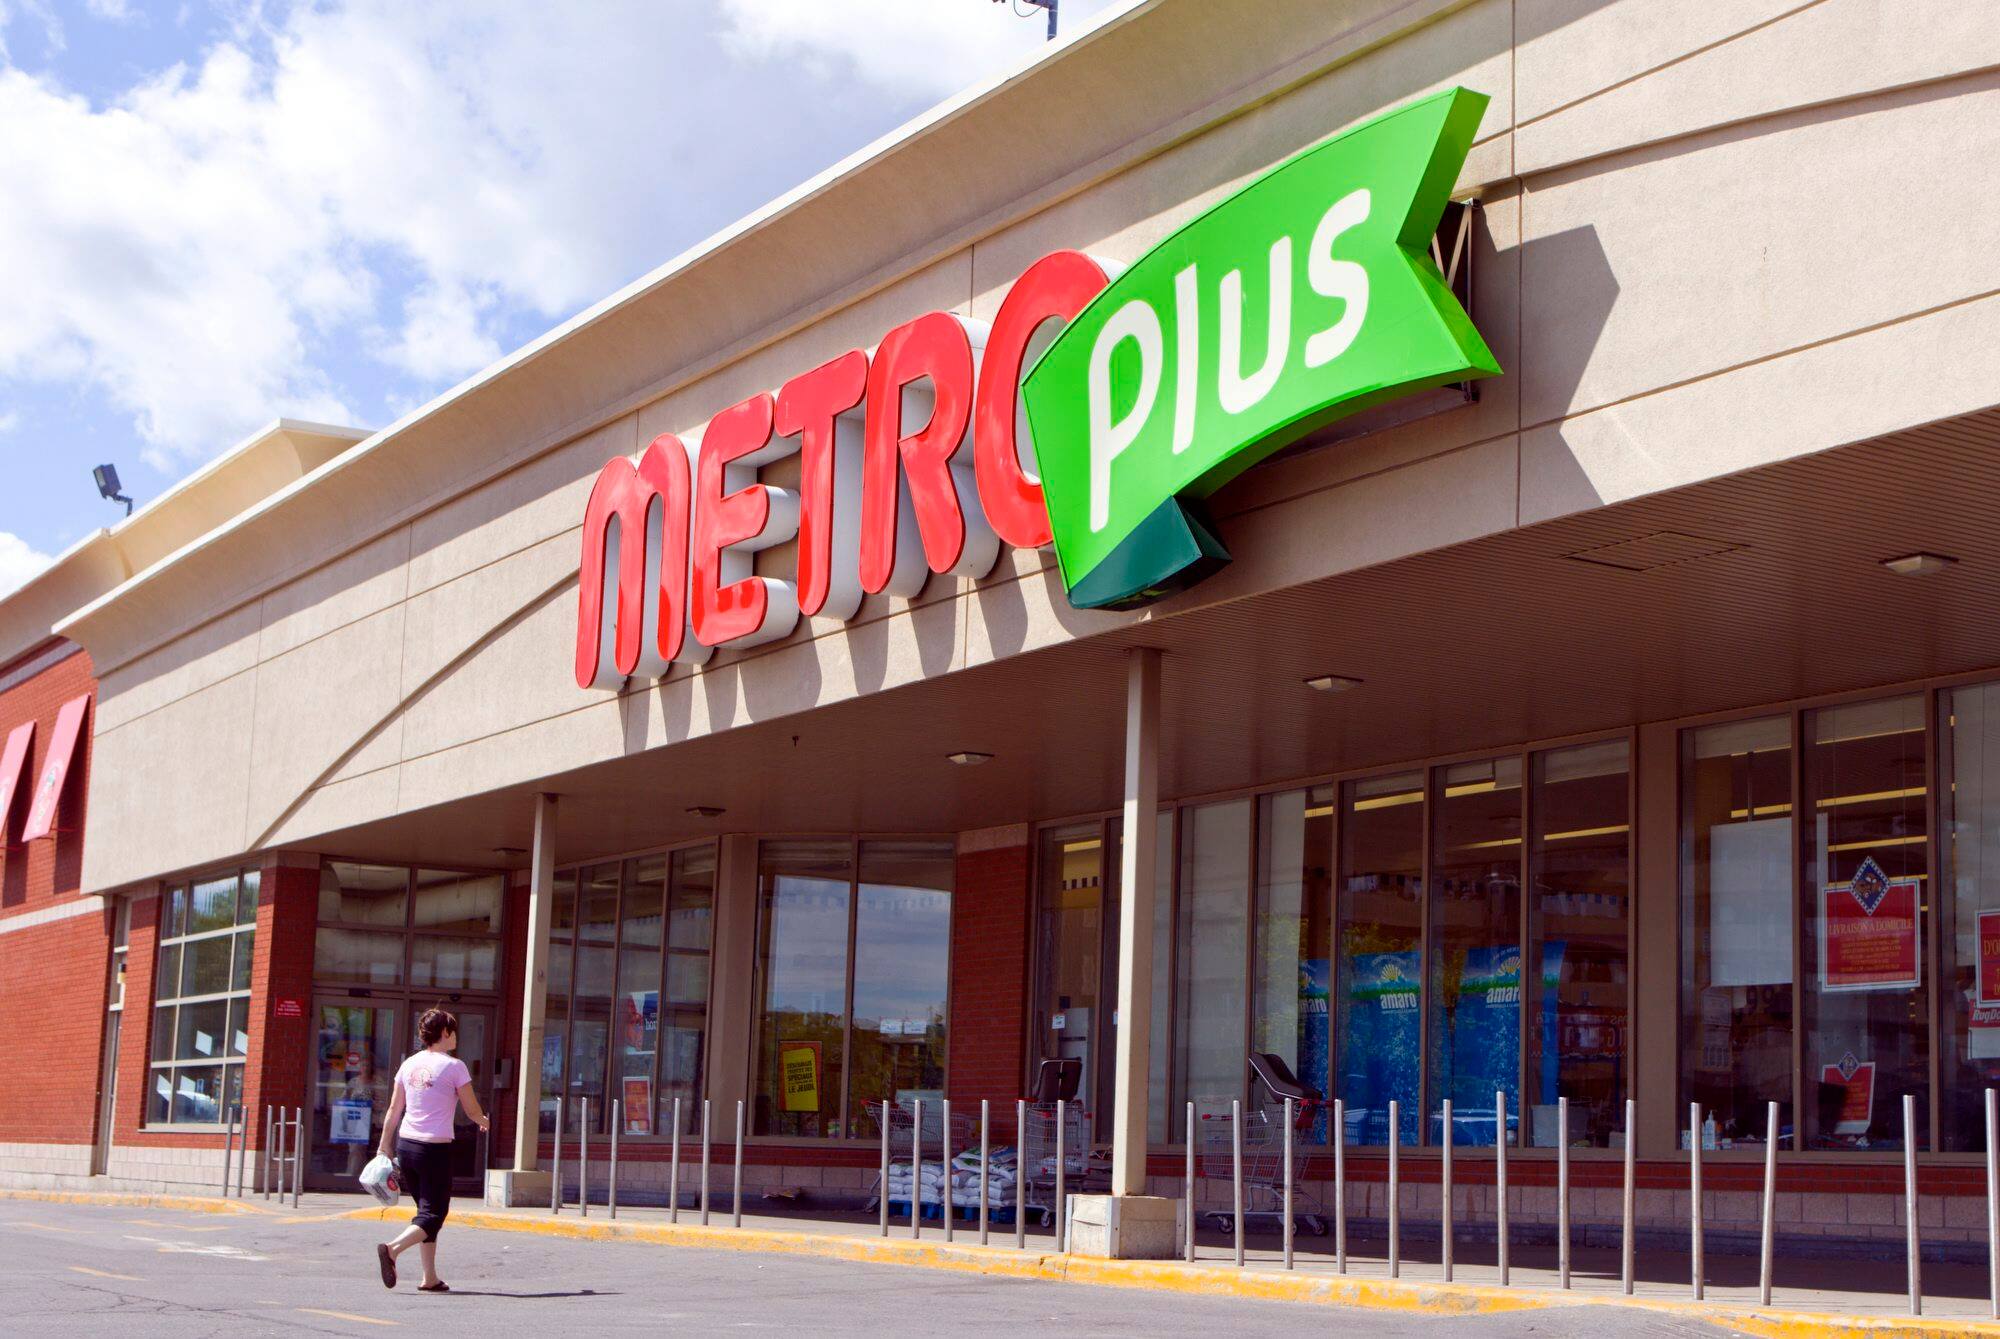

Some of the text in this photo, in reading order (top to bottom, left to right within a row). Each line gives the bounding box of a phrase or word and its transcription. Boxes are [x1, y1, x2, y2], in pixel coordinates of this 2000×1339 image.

[575, 249, 1110, 689] METRO
[1088, 188, 1371, 533] plus
[1379, 992, 1417, 1010] amaro
